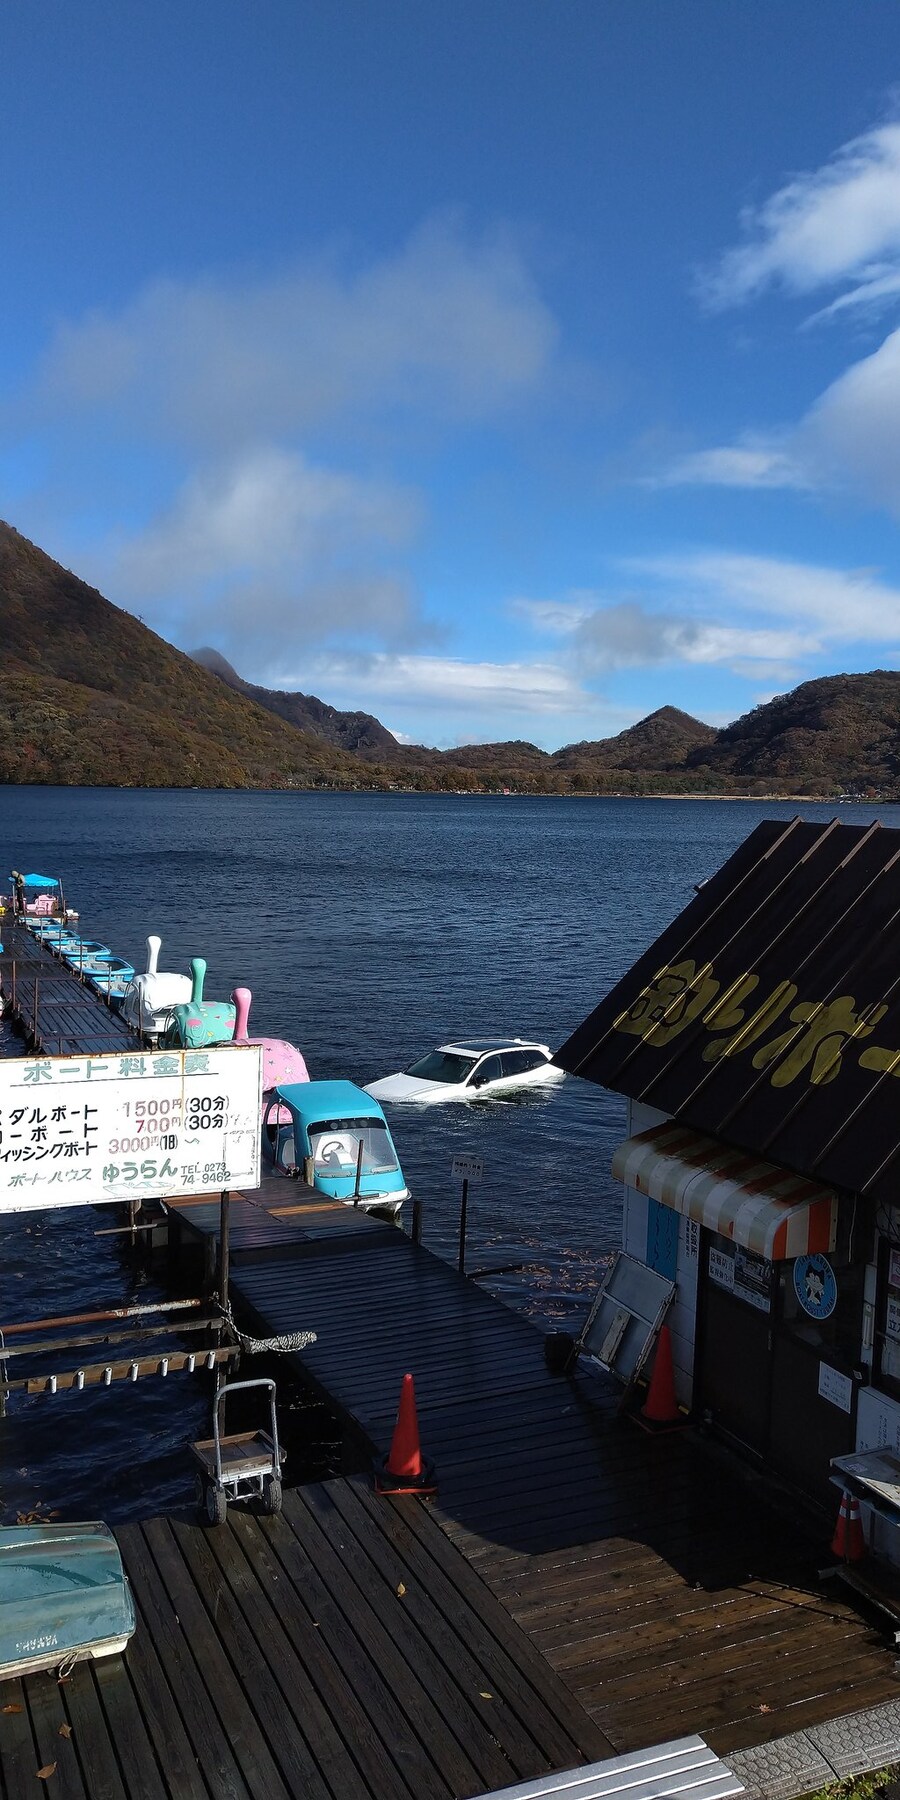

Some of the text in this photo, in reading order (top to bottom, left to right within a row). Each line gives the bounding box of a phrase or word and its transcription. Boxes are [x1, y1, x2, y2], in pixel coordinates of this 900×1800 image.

[0, 1103, 98, 1126] ダルボート
[102, 1157, 179, 1183] ゆうらん
[180, 1171, 231, 1186] 74-9462
